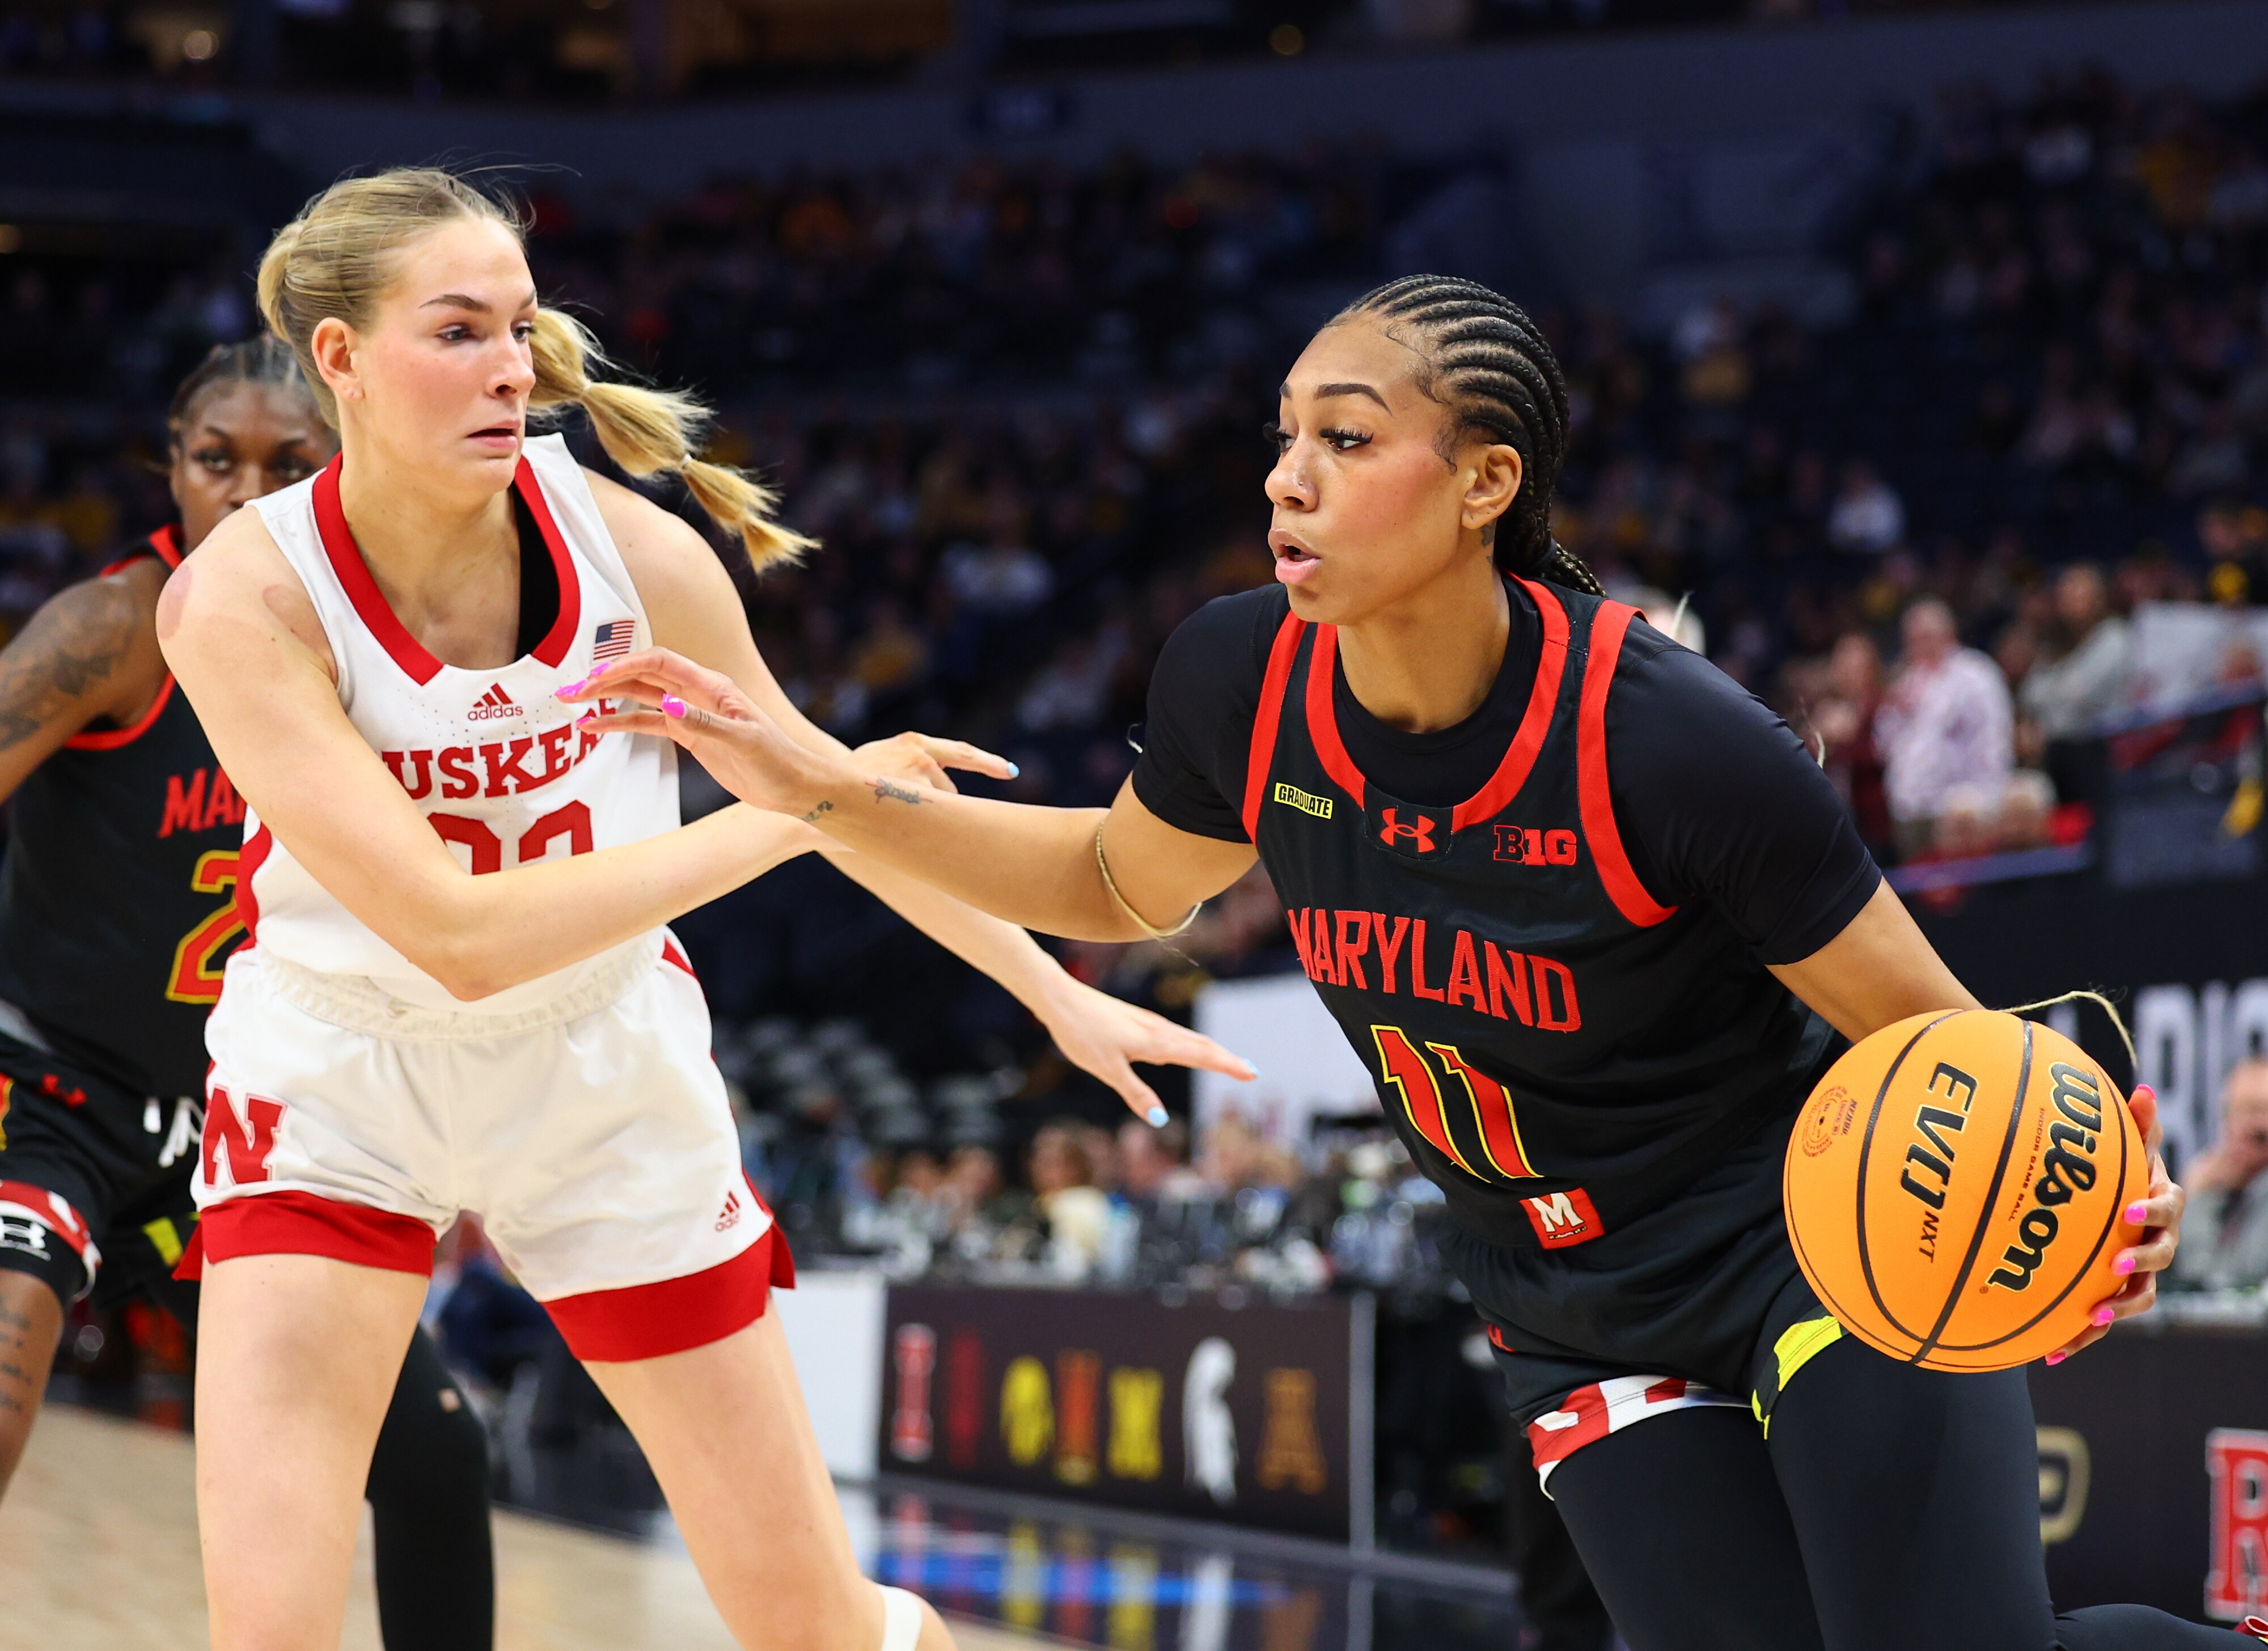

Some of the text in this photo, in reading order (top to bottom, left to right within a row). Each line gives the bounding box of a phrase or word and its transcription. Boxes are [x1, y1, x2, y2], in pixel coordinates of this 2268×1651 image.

[382, 698, 616, 799] USKE
[467, 705, 523, 721] adidas
[156, 767, 247, 839] MA
[1278, 785, 1331, 816] GRADUATE
[1287, 907, 1582, 1034] MARYLAND
[201, 1083, 287, 1189] N
[1370, 1025, 1545, 1183] 11
[1529, 1192, 1585, 1233] M
[1984, 1061, 2102, 1293] Wilson
[2008, 1107, 2045, 1222] INDOOR GAME BALL
[1919, 1212, 1941, 1264] NXT
